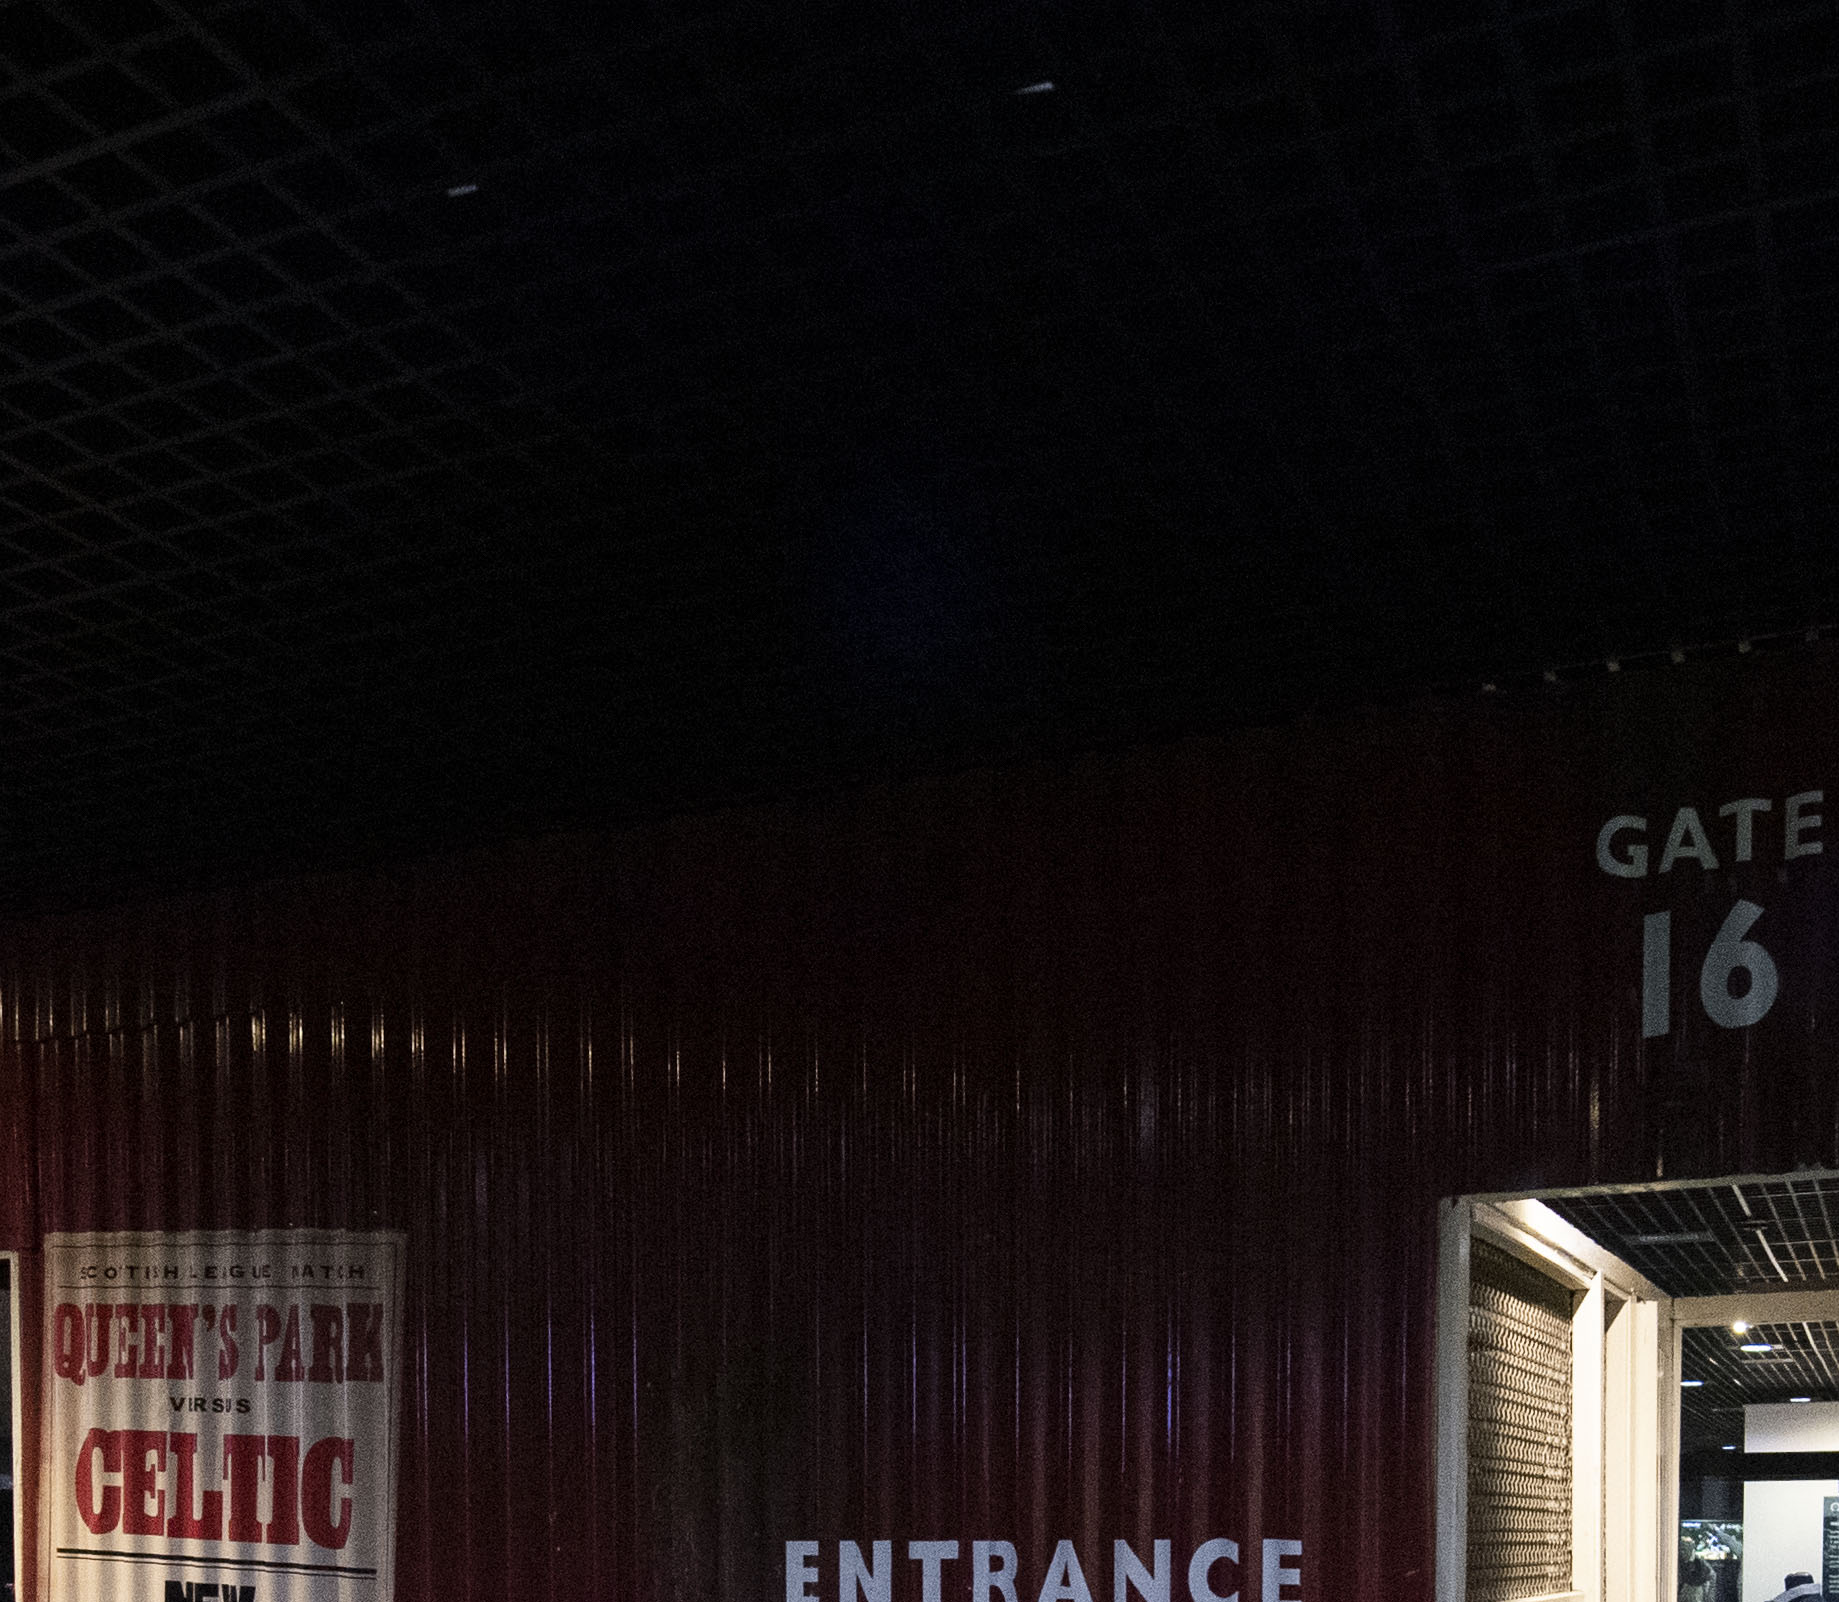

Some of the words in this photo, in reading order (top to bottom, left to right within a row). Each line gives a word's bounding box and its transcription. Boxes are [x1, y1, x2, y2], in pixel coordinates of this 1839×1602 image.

[1596, 790, 1824, 878] GATE
[1641, 899, 1779, 1039] 16
[53, 1303, 239, 1386] QUEEN'S
[254, 1303, 385, 1384] PARK
[75, 1427, 354, 1550] CELTIC
